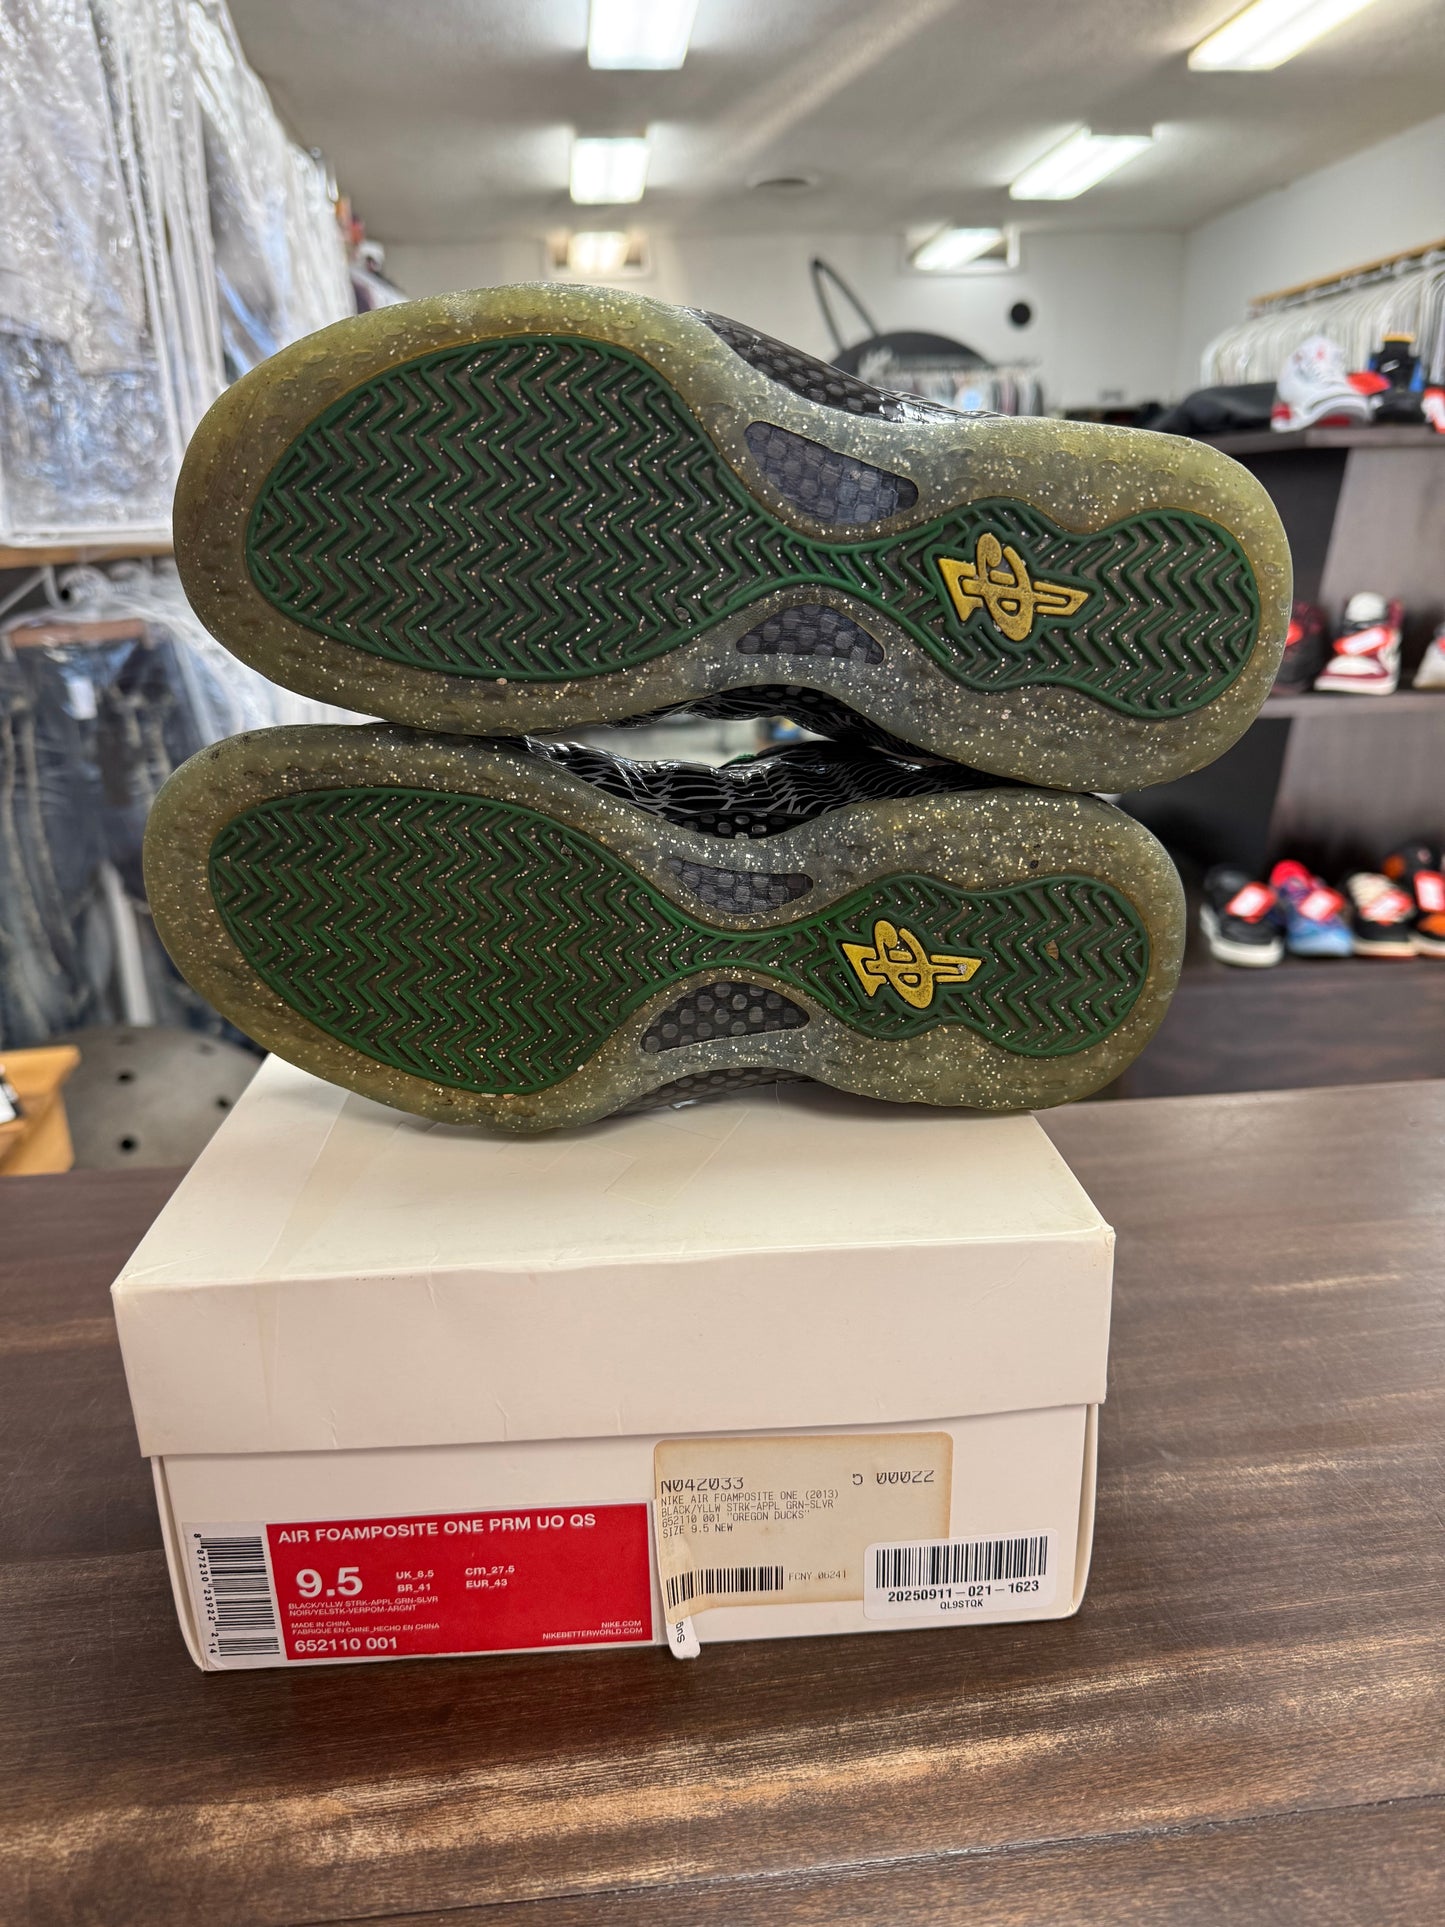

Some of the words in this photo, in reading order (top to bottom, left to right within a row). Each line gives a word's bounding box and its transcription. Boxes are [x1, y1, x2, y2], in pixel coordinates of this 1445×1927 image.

[661, 1495, 683, 1506] NIKE
[691, 1494, 708, 1503] AIR
[714, 1492, 773, 1502] FOAMPOSITE
[780, 1490, 798, 1499] ONE
[805, 1489, 839, 1500] (2013)
[661, 1503, 721, 1517] BLACK/YLLW
[727, 1501, 780, 1512] STRK-APPL
[786, 1500, 834, 1510] GRN-SLVR
[662, 1514, 697, 1528] 652110
[703, 1513, 721, 1523] 001
[278, 1530, 310, 1544] AIR
[315, 1522, 439, 1542] FOAMPOSITE
[444, 1519, 484, 1534] ONE
[489, 1516, 531, 1532] PRM
[537, 1515, 565, 1529] UO
[570, 1513, 596, 1528] QS
[663, 1526, 685, 1539] SIZE
[691, 1524, 709, 1533] 9.5
[715, 1523, 733, 1533] NEW
[296, 1566, 363, 1598] 9.5
[940, 1599, 983, 1610] QL9STQK
[292, 1627, 331, 1635] FABRIQUE
[326, 1620, 351, 1628] CHINA
[601, 1620, 641, 1629] NIKE.COM
[542, 1627, 643, 1640] NIKEBETTERWORLD.COM
[294, 1638, 361, 1653] 652110
[366, 1636, 398, 1650] 001
